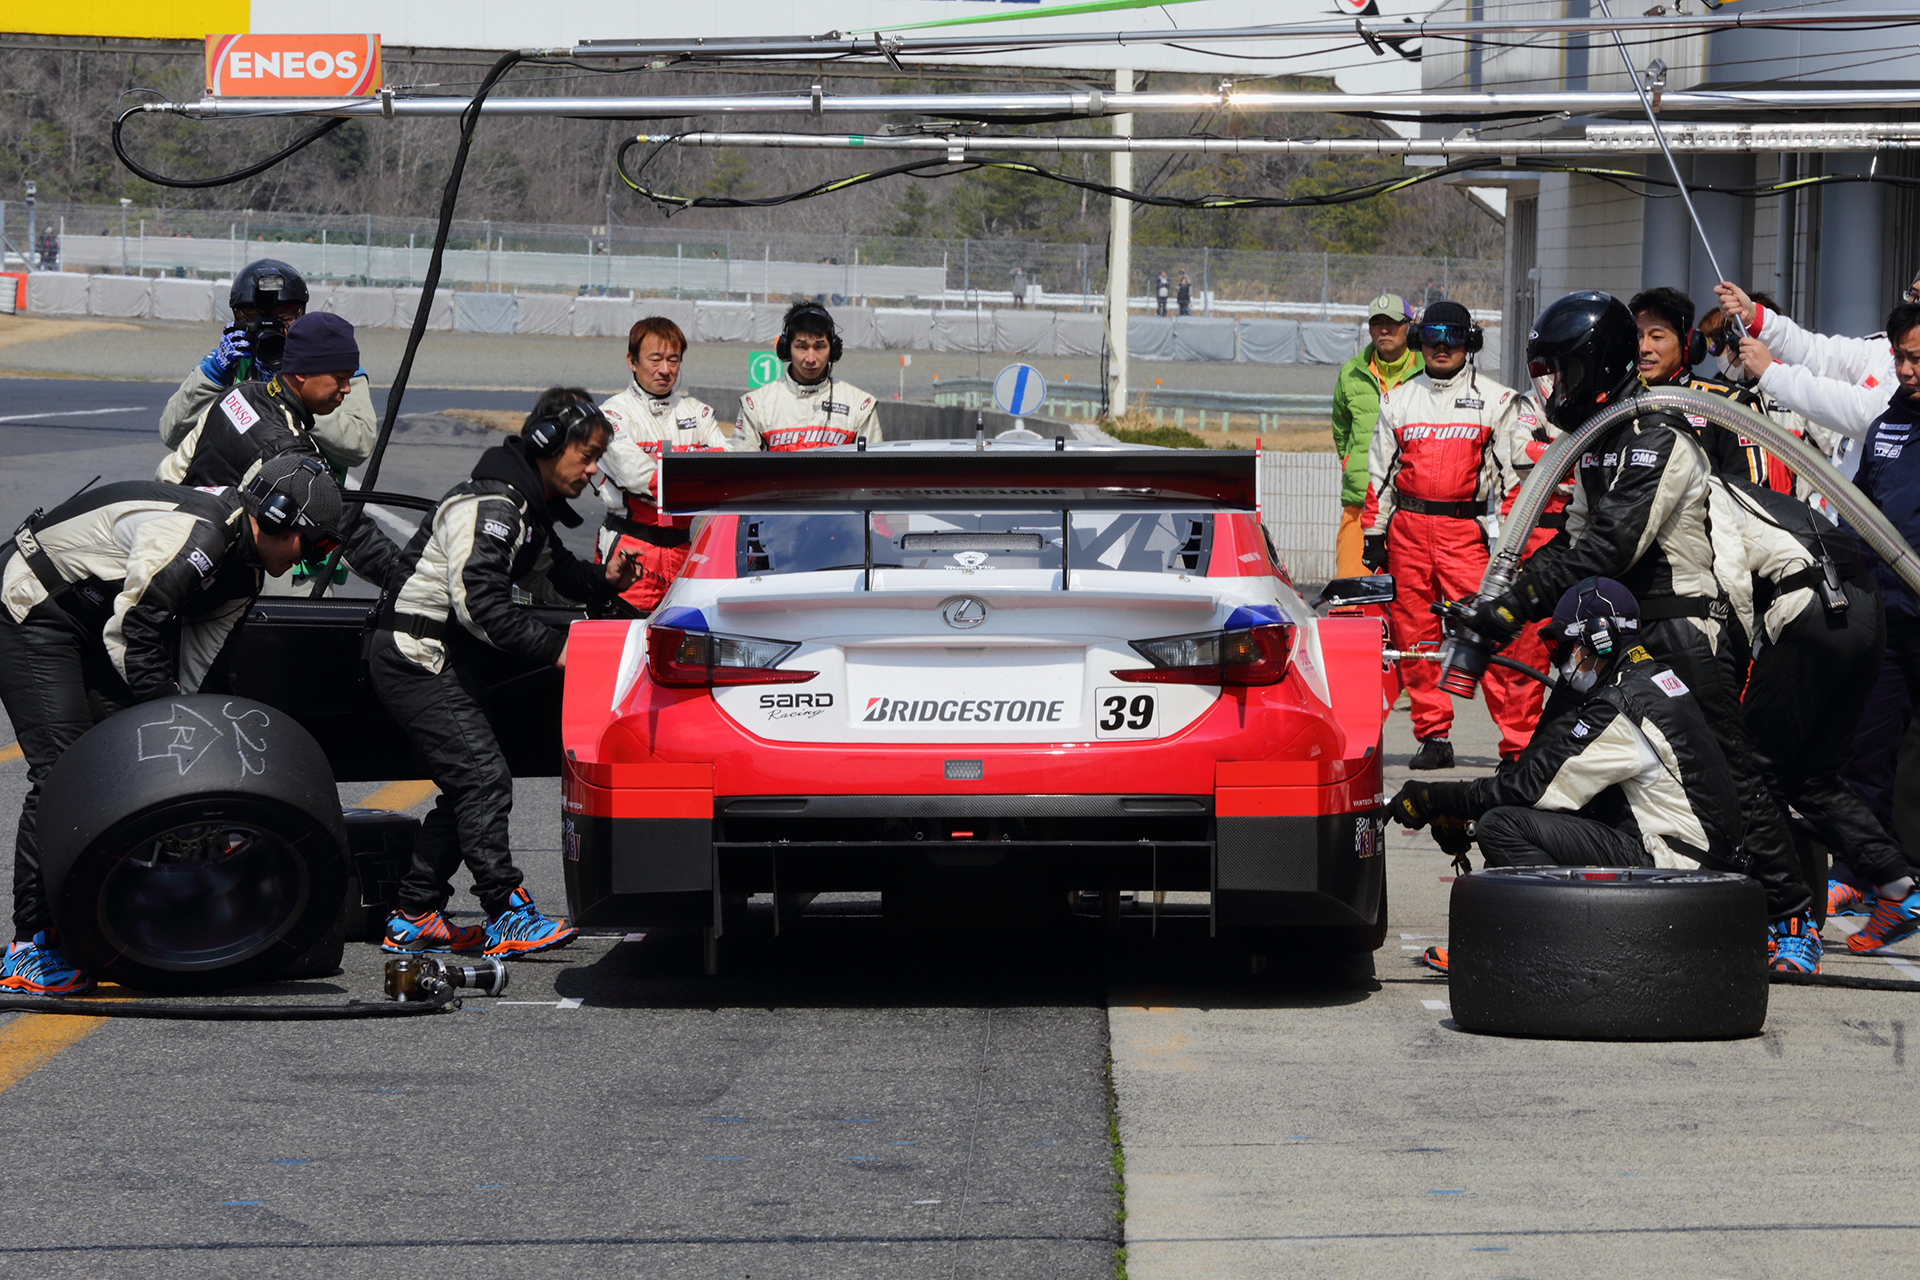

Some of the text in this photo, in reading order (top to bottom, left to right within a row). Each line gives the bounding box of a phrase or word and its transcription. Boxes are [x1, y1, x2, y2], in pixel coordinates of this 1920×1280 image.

[230, 51, 358, 79] ENEOS
[760, 360, 771, 381] 1
[225, 394, 252, 426] DENSO
[1631, 452, 1657, 464] OMP
[484, 522, 509, 537] OMP
[189, 550, 211, 572] OMP
[83, 586, 105, 602] OMP
[1661, 676, 1682, 691] DEN
[767, 708, 825, 721] Racing
[862, 697, 1064, 723] BRIDGESTONE
[1100, 694, 1154, 731] 39
[1573, 722, 1589, 737] MP
